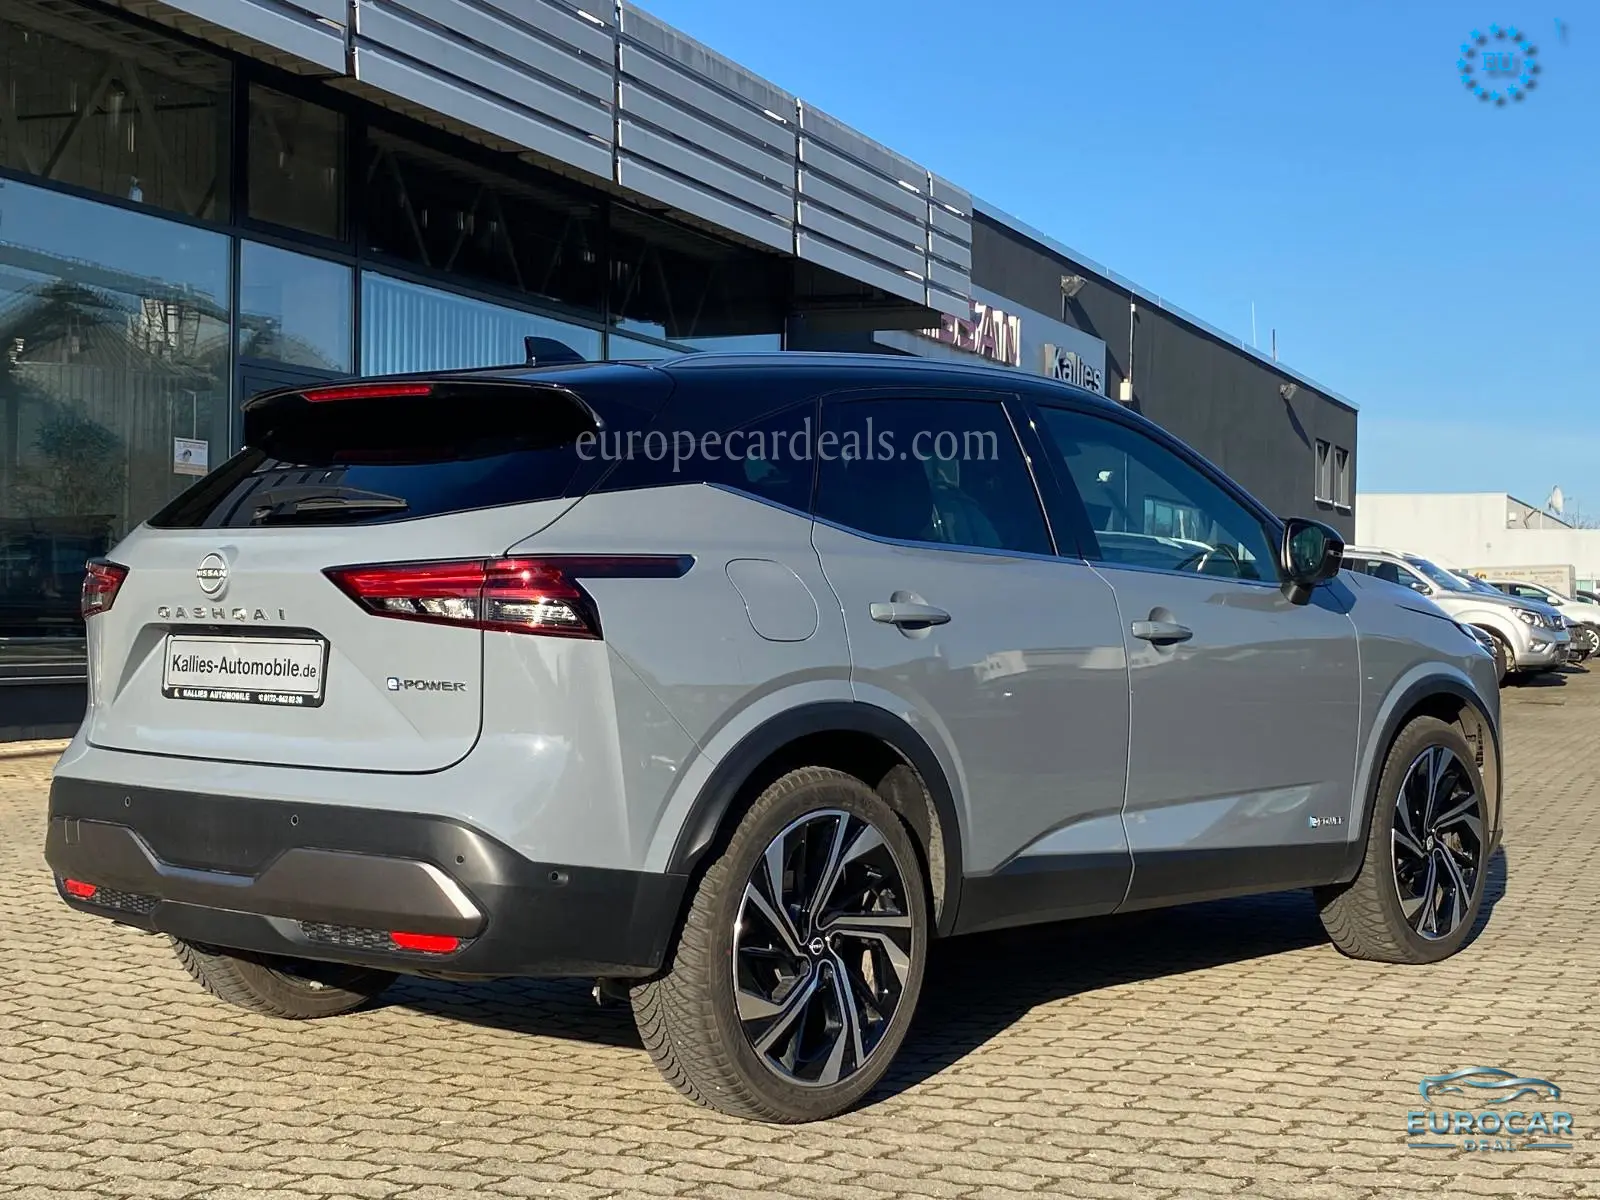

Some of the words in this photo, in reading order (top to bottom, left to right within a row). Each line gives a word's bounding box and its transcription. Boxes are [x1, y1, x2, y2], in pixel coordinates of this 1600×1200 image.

[1044, 343, 1101, 394] Kallies
[197, 568, 228, 578] NISSAN
[157, 605, 286, 622] QASHQAI
[171, 654, 317, 678] Kallies-Automobile.de
[183, 688, 208, 698] KALLIES
[209, 690, 250, 701] AUTOMOBILE
